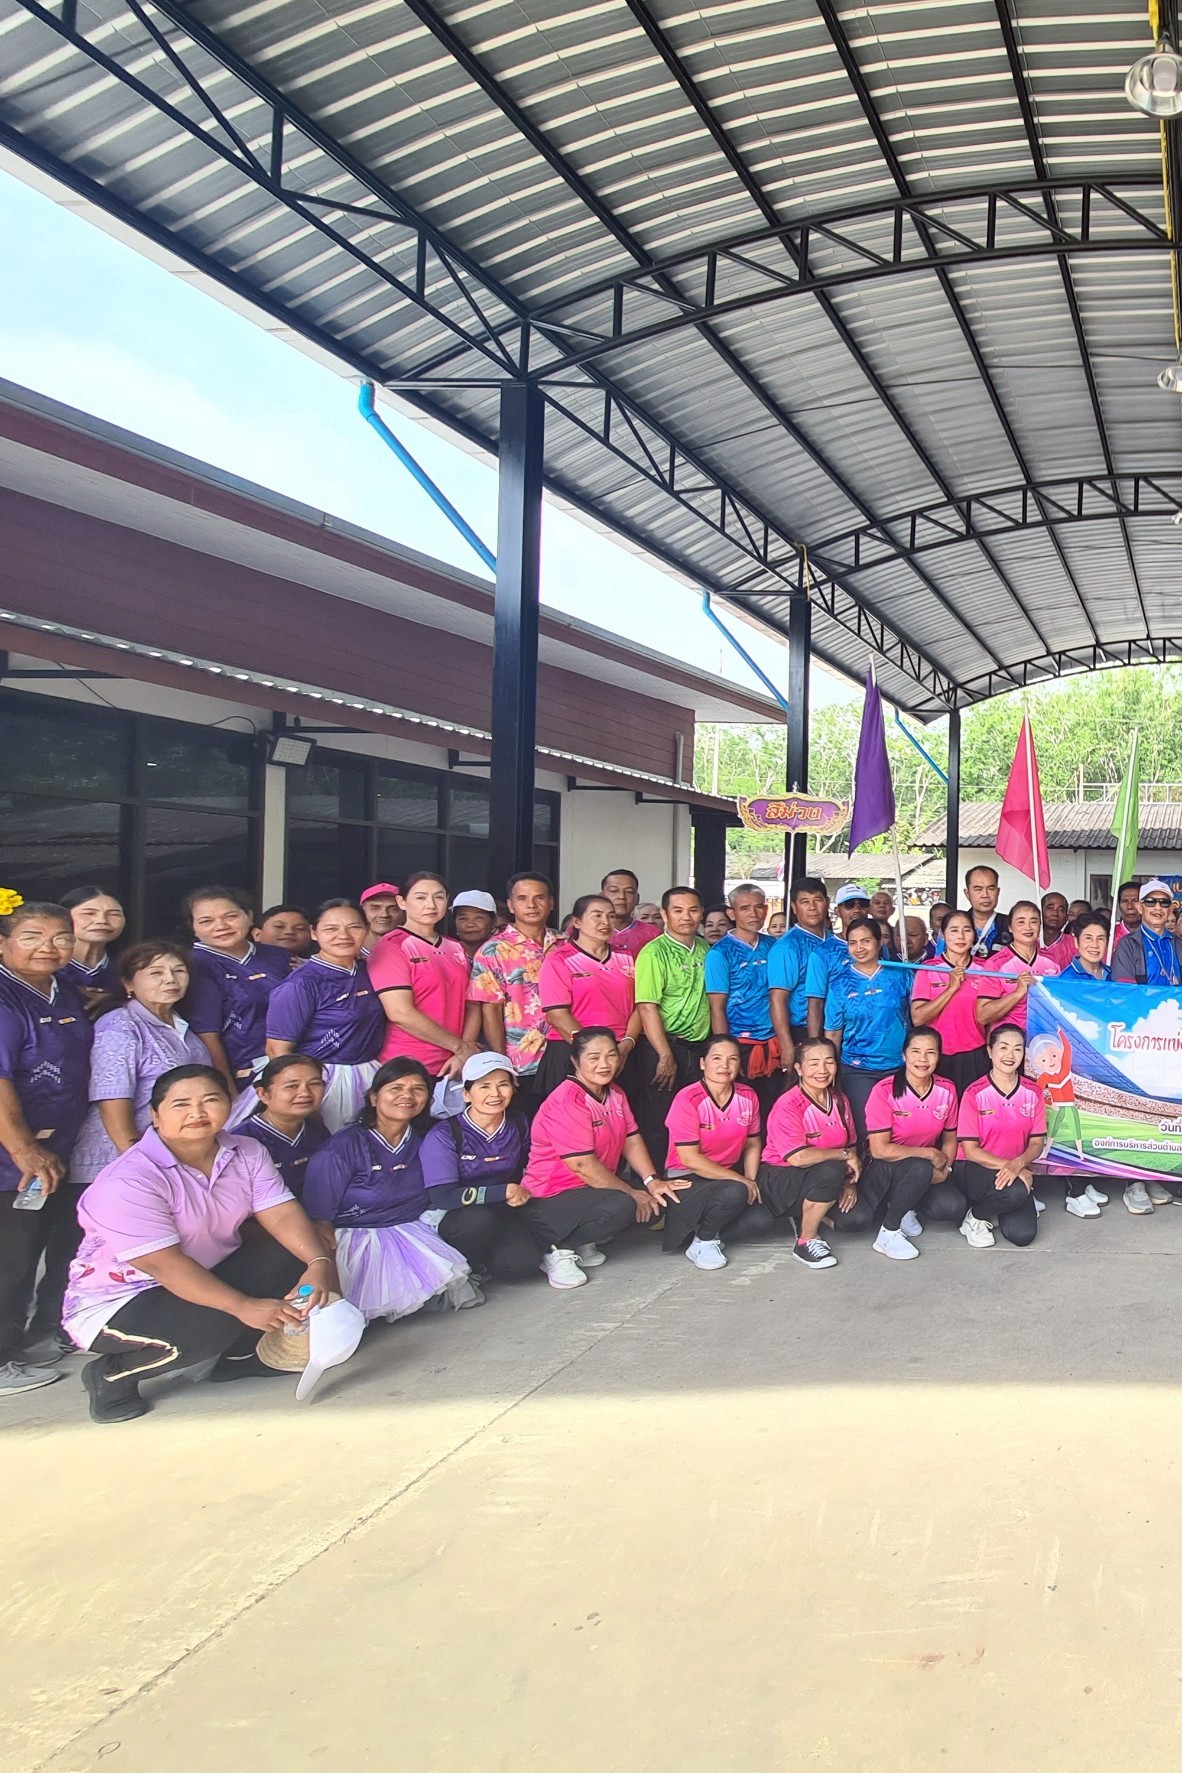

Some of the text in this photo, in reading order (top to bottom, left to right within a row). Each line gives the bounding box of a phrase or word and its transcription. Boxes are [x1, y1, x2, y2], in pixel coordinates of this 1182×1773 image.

[766, 801, 822, 820] สีม่วง
[1160, 1118, 1182, 1133] วันที่
